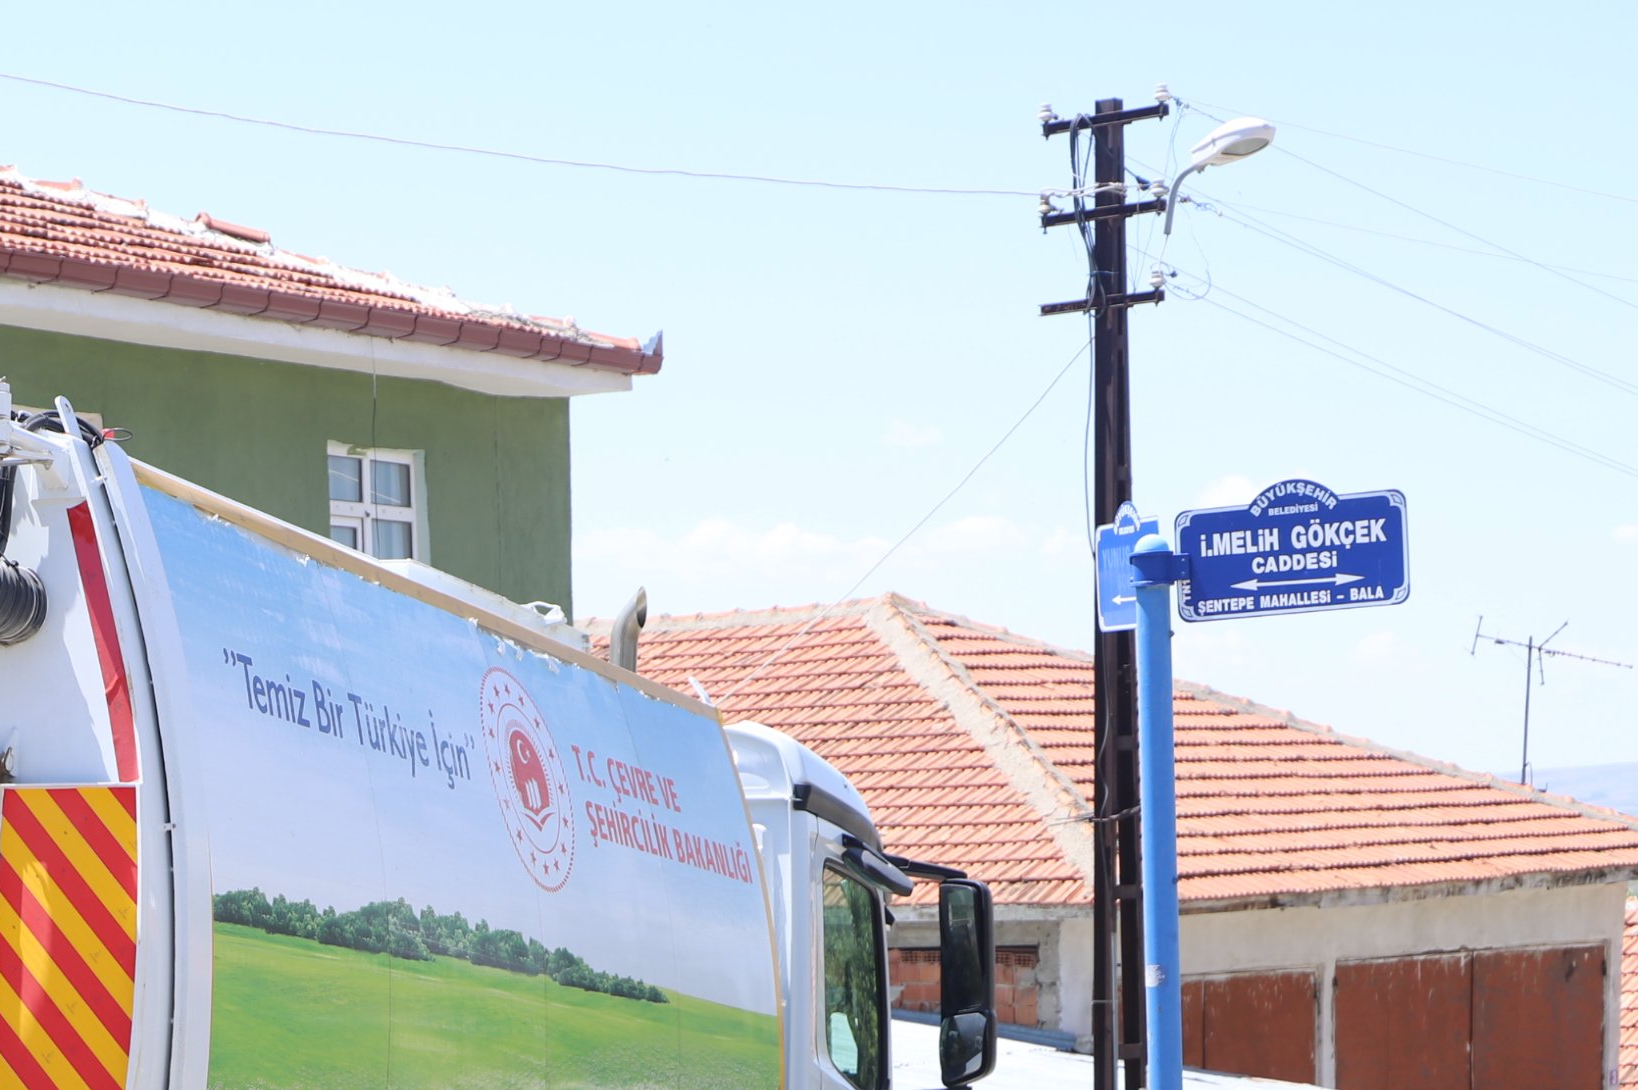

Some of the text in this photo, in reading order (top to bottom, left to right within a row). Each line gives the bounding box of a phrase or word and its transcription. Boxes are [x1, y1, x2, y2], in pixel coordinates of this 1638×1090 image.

[1249, 482, 1338, 518] BÜYÜKŞEHİR
[1268, 501, 1319, 516] BELEDİYESİ
[1291, 518, 1388, 549] GÖKÇEK
[1198, 596, 1255, 616] ŞENTEPE
[1350, 586, 1385, 601] BALA
[312, 680, 344, 739] Bir
[347, 692, 430, 778] Türkiye
[571, 744, 682, 813] T.C. ÇEVRE VE
[585, 800, 754, 885] ŞEHİRCİLİK BAKANLIĞI
